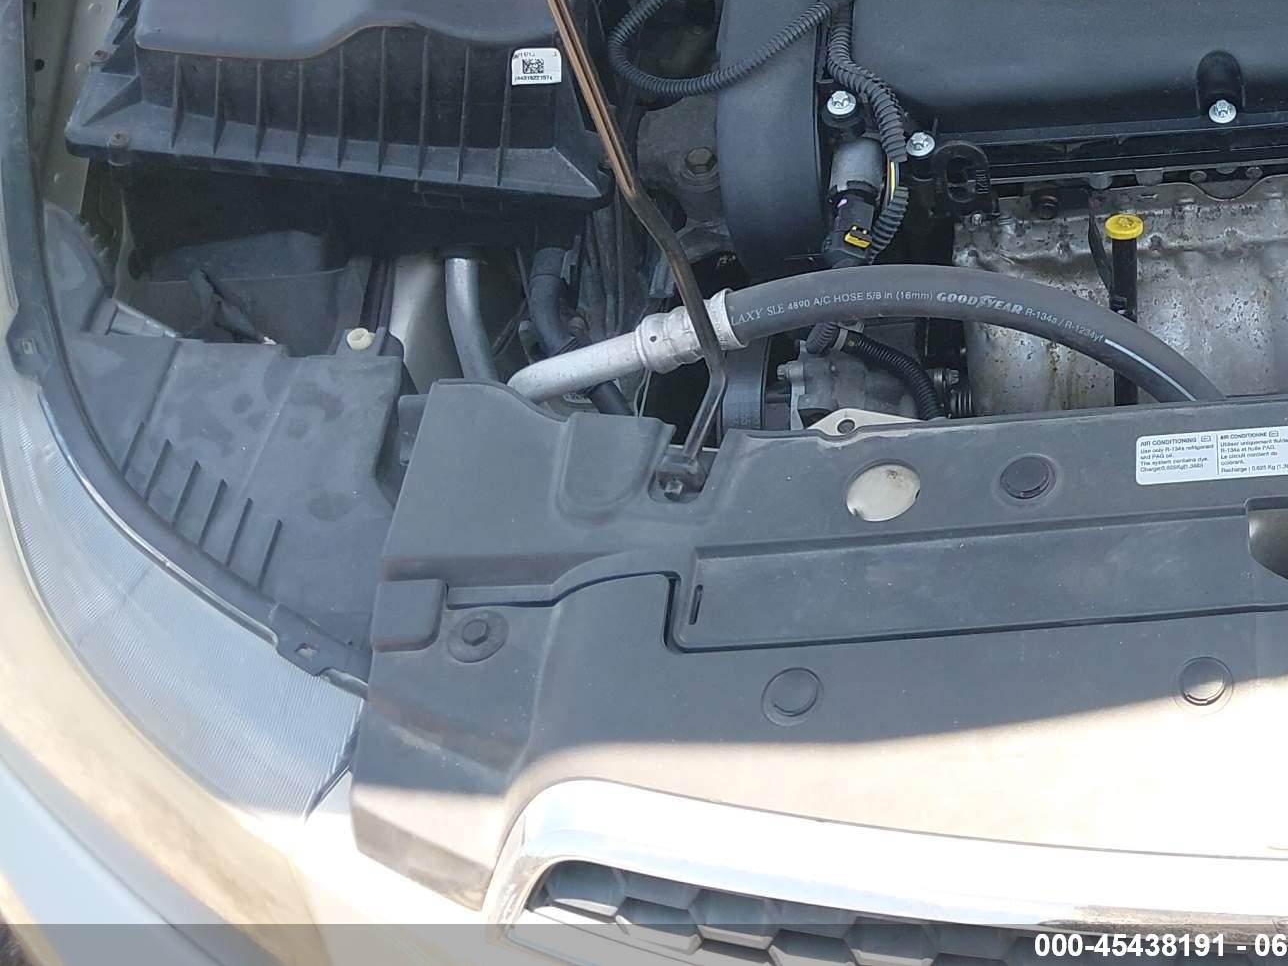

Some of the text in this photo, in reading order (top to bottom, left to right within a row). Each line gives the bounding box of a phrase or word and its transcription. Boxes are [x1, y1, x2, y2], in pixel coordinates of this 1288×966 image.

[767, 304, 785, 316] SLE
[813, 295, 831, 306] A/C
[834, 291, 864, 304] HOSE
[866, 291, 882, 300] 5/8
[884, 290, 893, 300] in
[896, 290, 933, 302] (16mm)
[936, 291, 1024, 315] GOODYEAR
[1025, 307, 1058, 325] R-134a
[1064, 320, 1104, 344] R-1234yf
[1152, 437, 1197, 446] CONDITIONING
